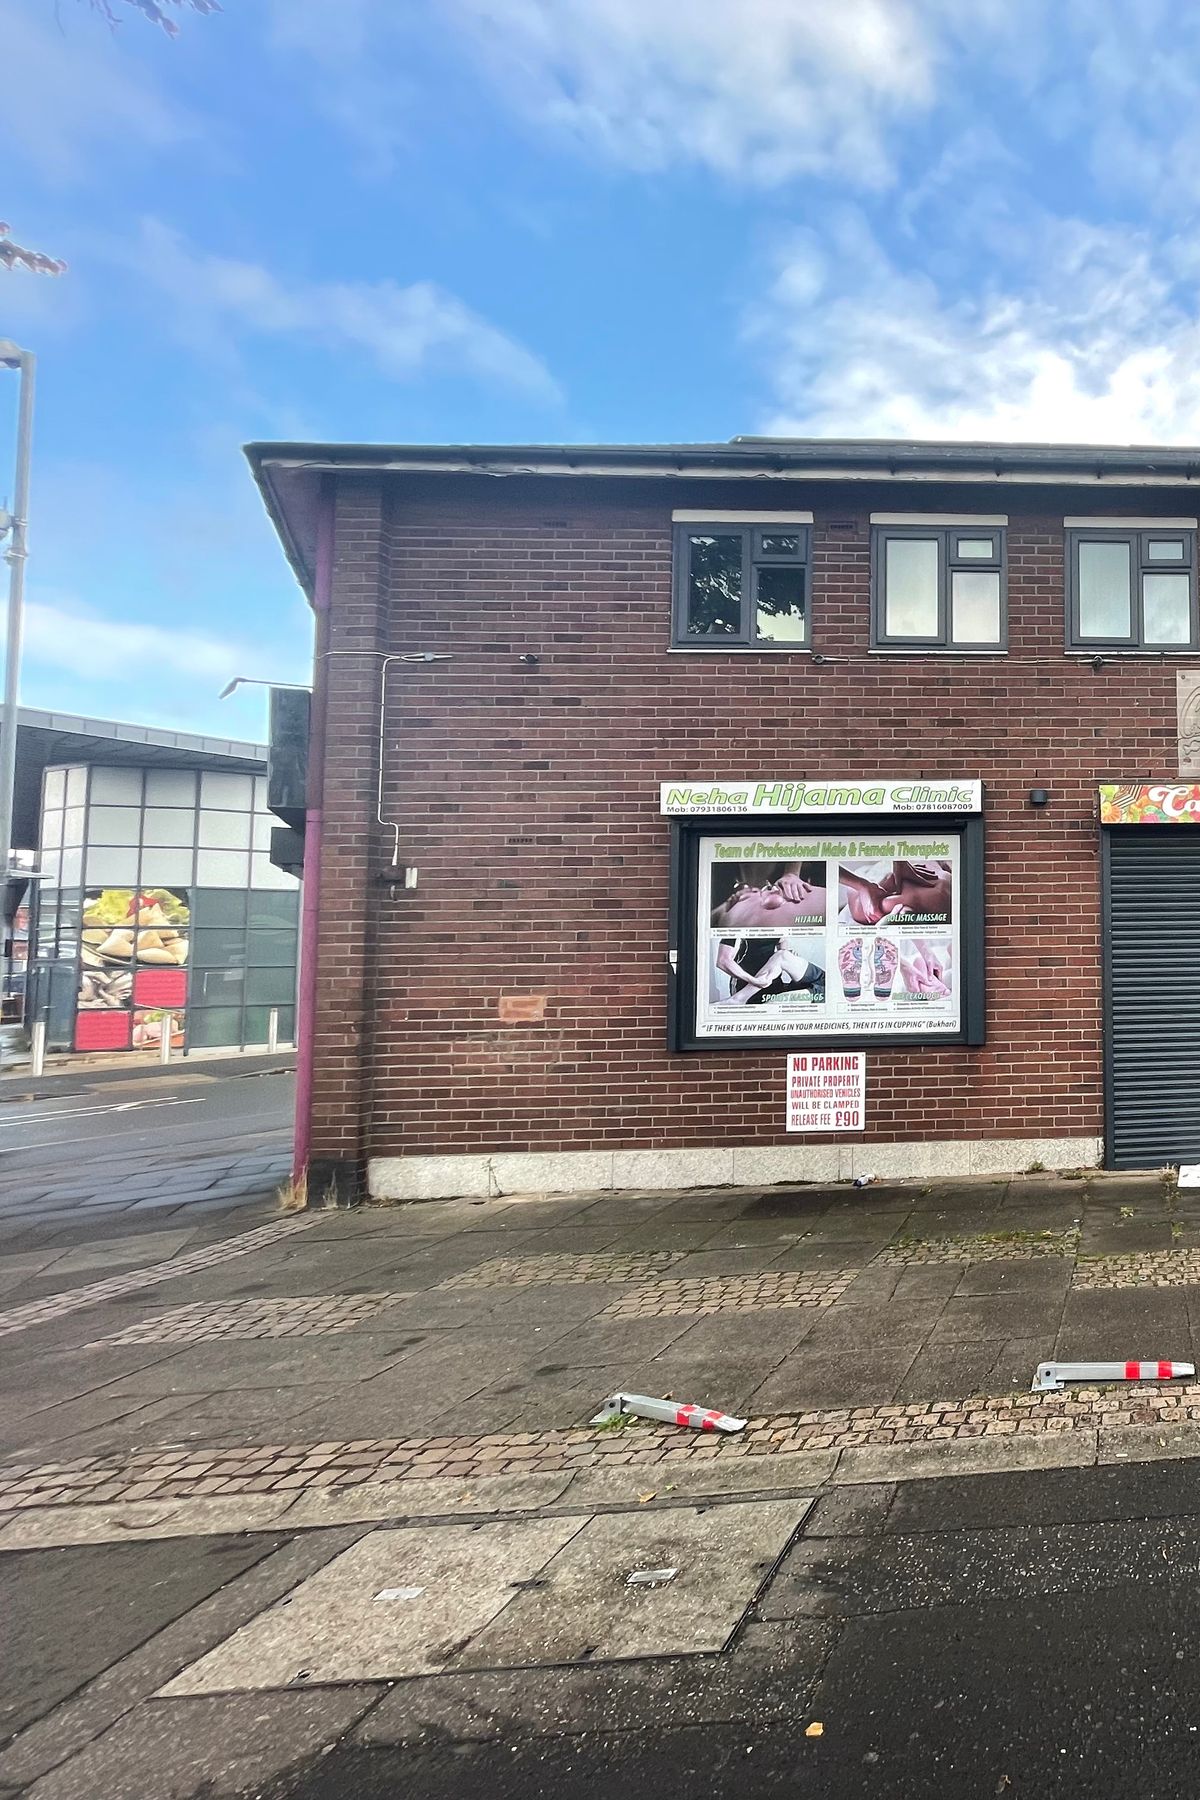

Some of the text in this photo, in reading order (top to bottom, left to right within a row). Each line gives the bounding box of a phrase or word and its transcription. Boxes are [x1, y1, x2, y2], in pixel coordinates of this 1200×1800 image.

[666, 783, 974, 812] Neha Hijama Clinic
[714, 841, 950, 859] Team of Professional Male & Female Therapists
[794, 915, 823, 924] HIJAMA
[915, 913, 947, 922] MASSAGE
[714, 1024, 735, 1032] THERE
[757, 1023, 786, 1031] HEALING
[786, 1023, 794, 1031] IN
[814, 1022, 851, 1030] MEDICINES,
[852, 1022, 870, 1030] THEN
[870, 1021, 877, 1029] IT
[877, 1021, 884, 1029] IS
[885, 1021, 892, 1029] IN
[793, 1056, 859, 1071] NO PARKING
[792, 1075, 859, 1087] PRIVATE PROPERTY
[791, 1088, 861, 1099] UNAUTHORISED VEHICLES
[792, 1100, 859, 1109] WILL BE CLAMPED
[791, 1111, 859, 1126] RELEASE FEE £90
